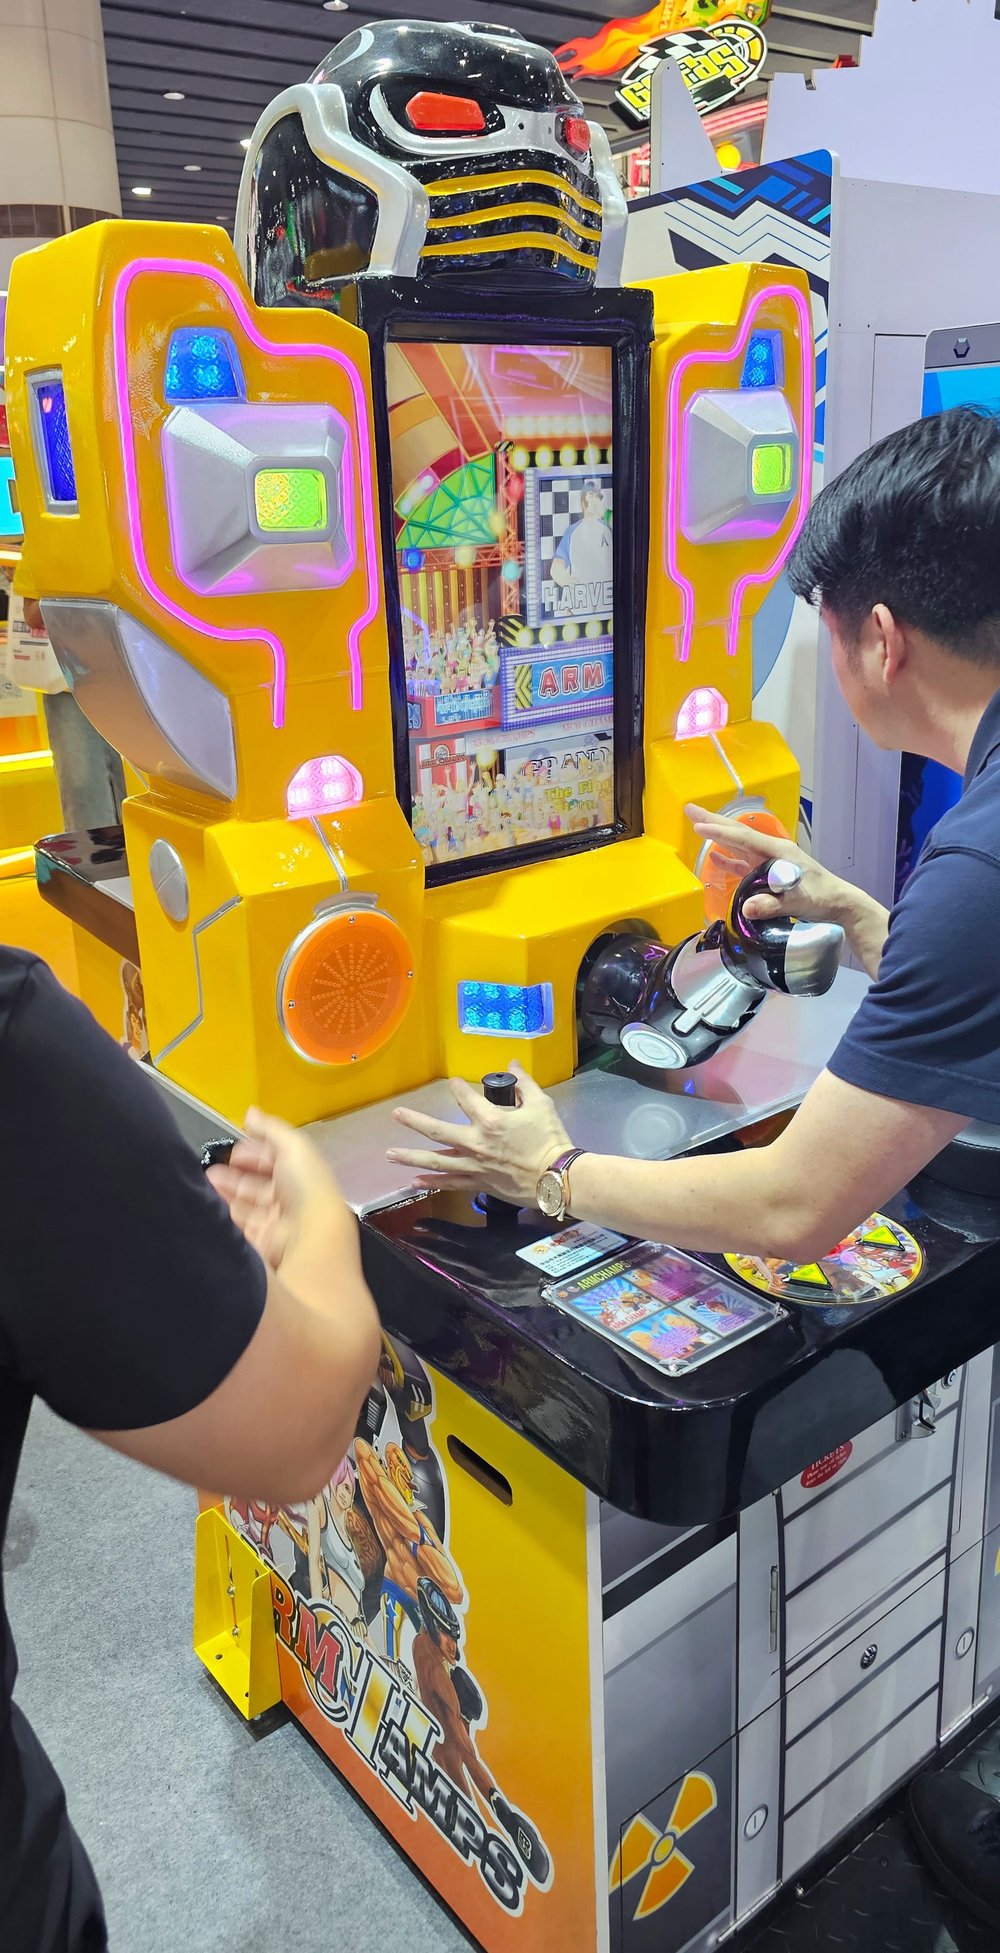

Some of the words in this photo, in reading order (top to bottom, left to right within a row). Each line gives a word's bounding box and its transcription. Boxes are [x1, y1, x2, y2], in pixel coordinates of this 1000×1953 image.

[543, 580, 613, 612] HARVE
[538, 660, 605, 699] ARM
[544, 786, 573, 800] The
[577, 1260, 631, 1290] ARMCHAMPS
[270, 1572, 343, 1702] RM
